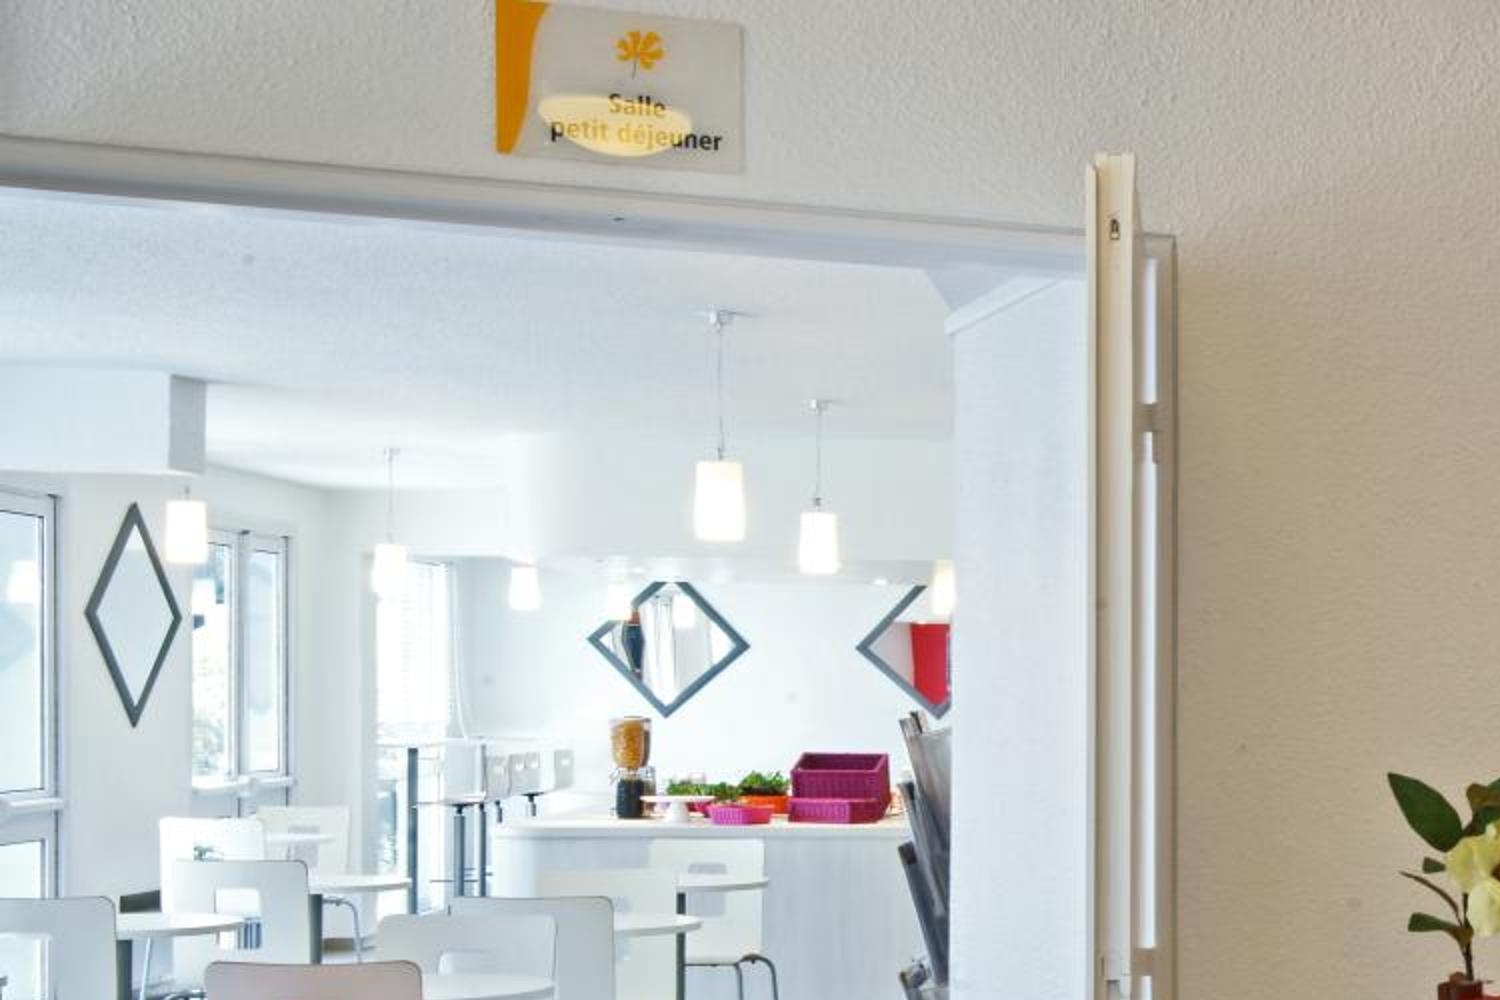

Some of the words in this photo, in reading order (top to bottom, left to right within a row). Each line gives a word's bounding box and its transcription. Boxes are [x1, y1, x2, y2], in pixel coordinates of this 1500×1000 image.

[608, 93, 667, 118] Salle
[551, 119, 609, 142] petit
[617, 122, 723, 151] déjeuner
